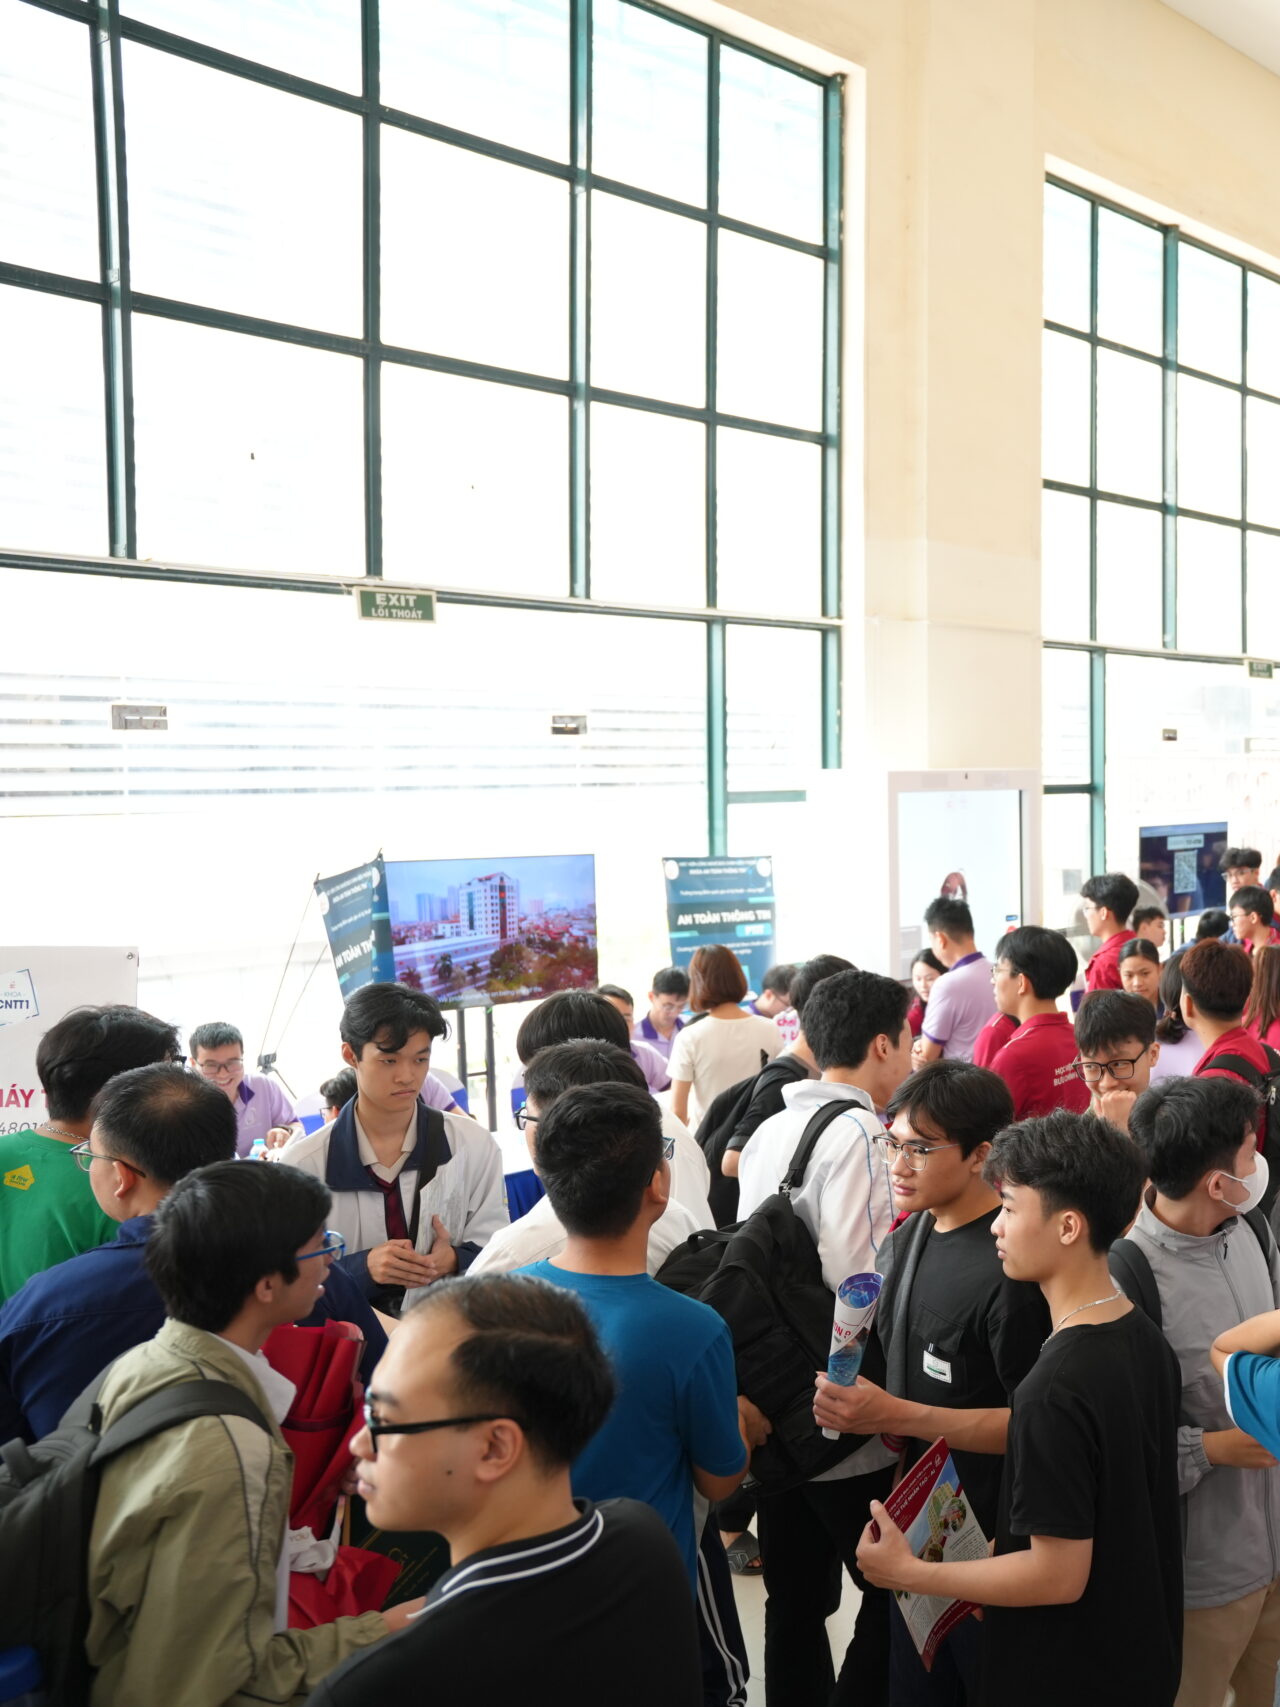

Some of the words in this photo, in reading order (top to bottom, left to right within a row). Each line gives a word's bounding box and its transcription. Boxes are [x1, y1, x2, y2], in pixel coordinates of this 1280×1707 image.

[375, 593, 417, 607] EXIT
[371, 605, 389, 617] LỐI
[391, 608, 423, 619] THOÁT
[677, 914, 693, 926] AN
[693, 910, 720, 925] TOÀN
[721, 909, 756, 924] THÔNG
[755, 909, 772, 921] TIN
